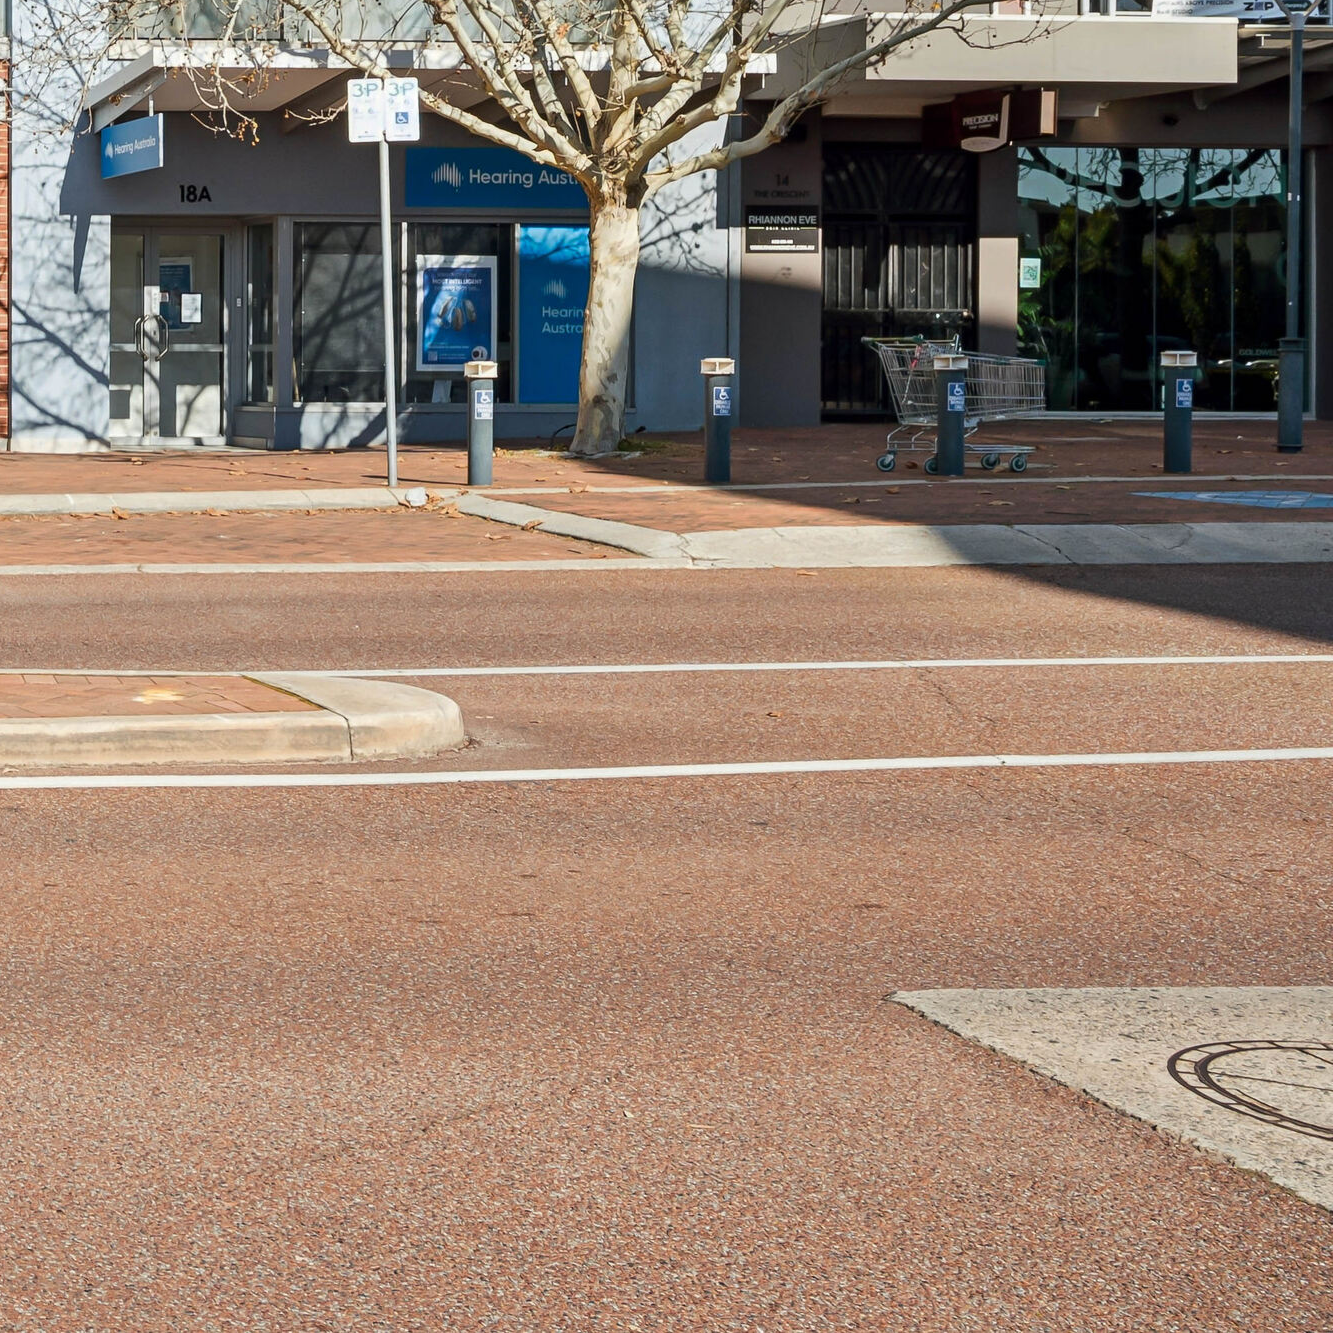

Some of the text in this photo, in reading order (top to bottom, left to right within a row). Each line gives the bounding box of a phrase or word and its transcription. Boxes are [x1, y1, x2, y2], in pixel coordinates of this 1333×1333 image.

[962, 113, 999, 126] PRECISION
[114, 142, 134, 155] Hearing
[469, 169, 579, 188] Hearing Austr
[179, 184, 212, 203] 18A
[748, 215, 817, 224] RHIANNON EVE
[542, 306, 584, 318] Hearin
[541, 322, 584, 334] Austra
